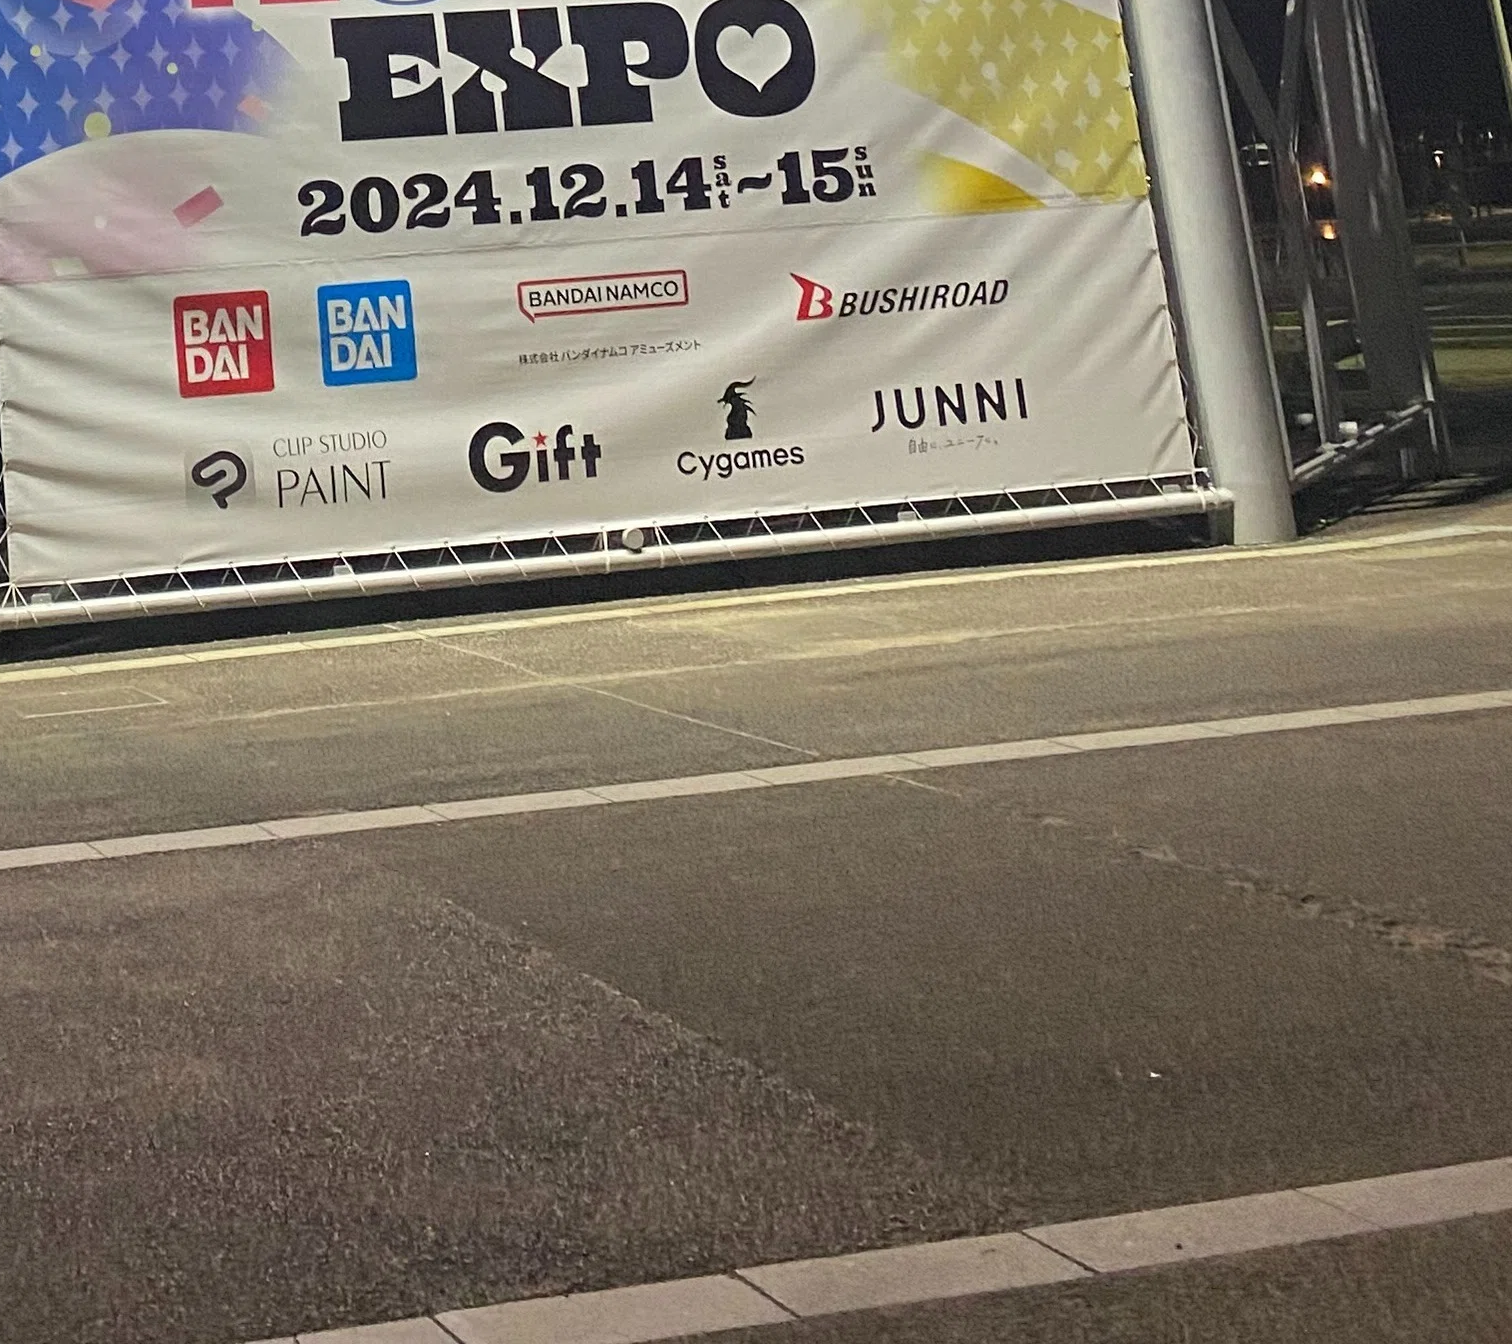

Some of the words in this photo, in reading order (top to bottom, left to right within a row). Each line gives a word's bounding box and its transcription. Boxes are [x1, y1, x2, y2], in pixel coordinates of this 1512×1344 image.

[326, 294, 406, 335] BAN
[529, 286, 602, 308] BANDAI
[606, 280, 679, 302] NAMCO
[838, 279, 1009, 318] BUSHIROAD
[183, 305, 263, 346] BAN
[186, 344, 251, 384] DAI
[330, 331, 392, 372] DAI
[871, 377, 1029, 433] JUNNI
[273, 436, 313, 458] CLIP
[319, 430, 387, 453] STUDIO
[468, 421, 602, 493] Gift
[677, 445, 805, 481] Cygames
[277, 460, 391, 508] PAINT
